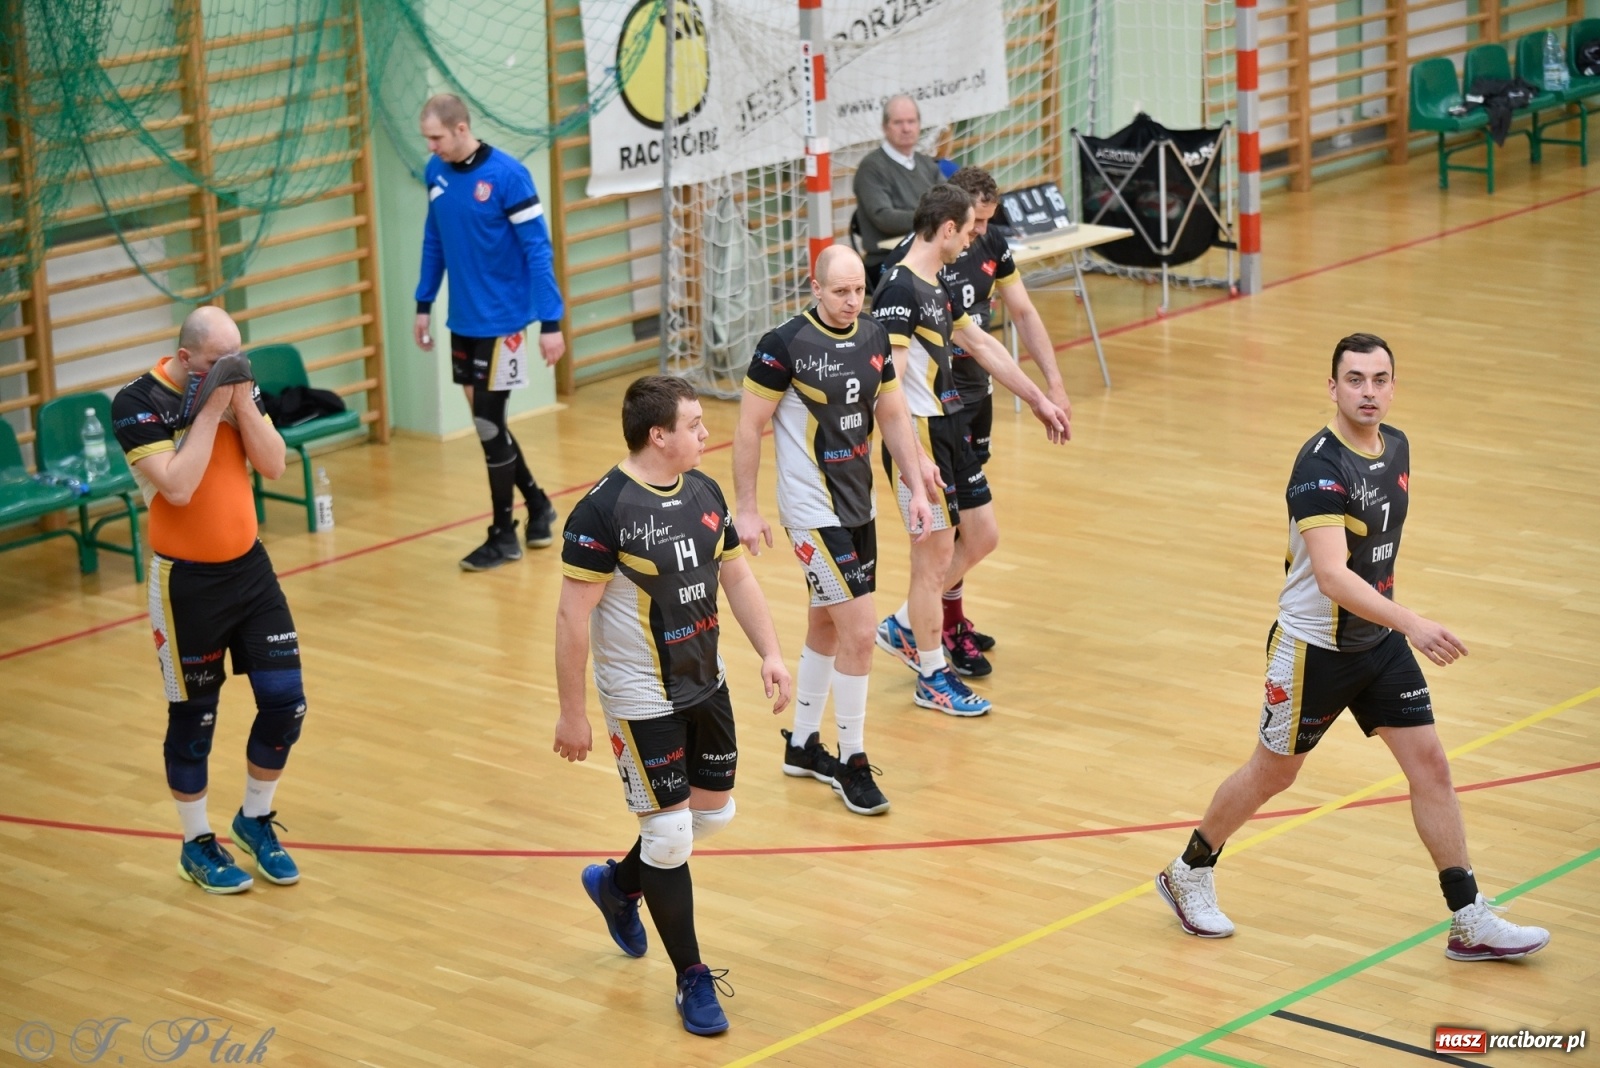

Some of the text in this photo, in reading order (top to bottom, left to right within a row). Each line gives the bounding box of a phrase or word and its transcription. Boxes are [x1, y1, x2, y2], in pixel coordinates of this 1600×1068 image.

[962, 284, 975, 308] 8
[509, 358, 518, 378] 3
[845, 378, 861, 404] 2
[840, 412, 863, 431] ENTER
[1381, 502, 1391, 533] 7
[641, 515, 673, 551] Hair
[674, 538, 699, 571] 14
[1372, 542, 1393, 563] ENTER
[678, 582, 707, 604] ENTER
[808, 571, 824, 594] 2
